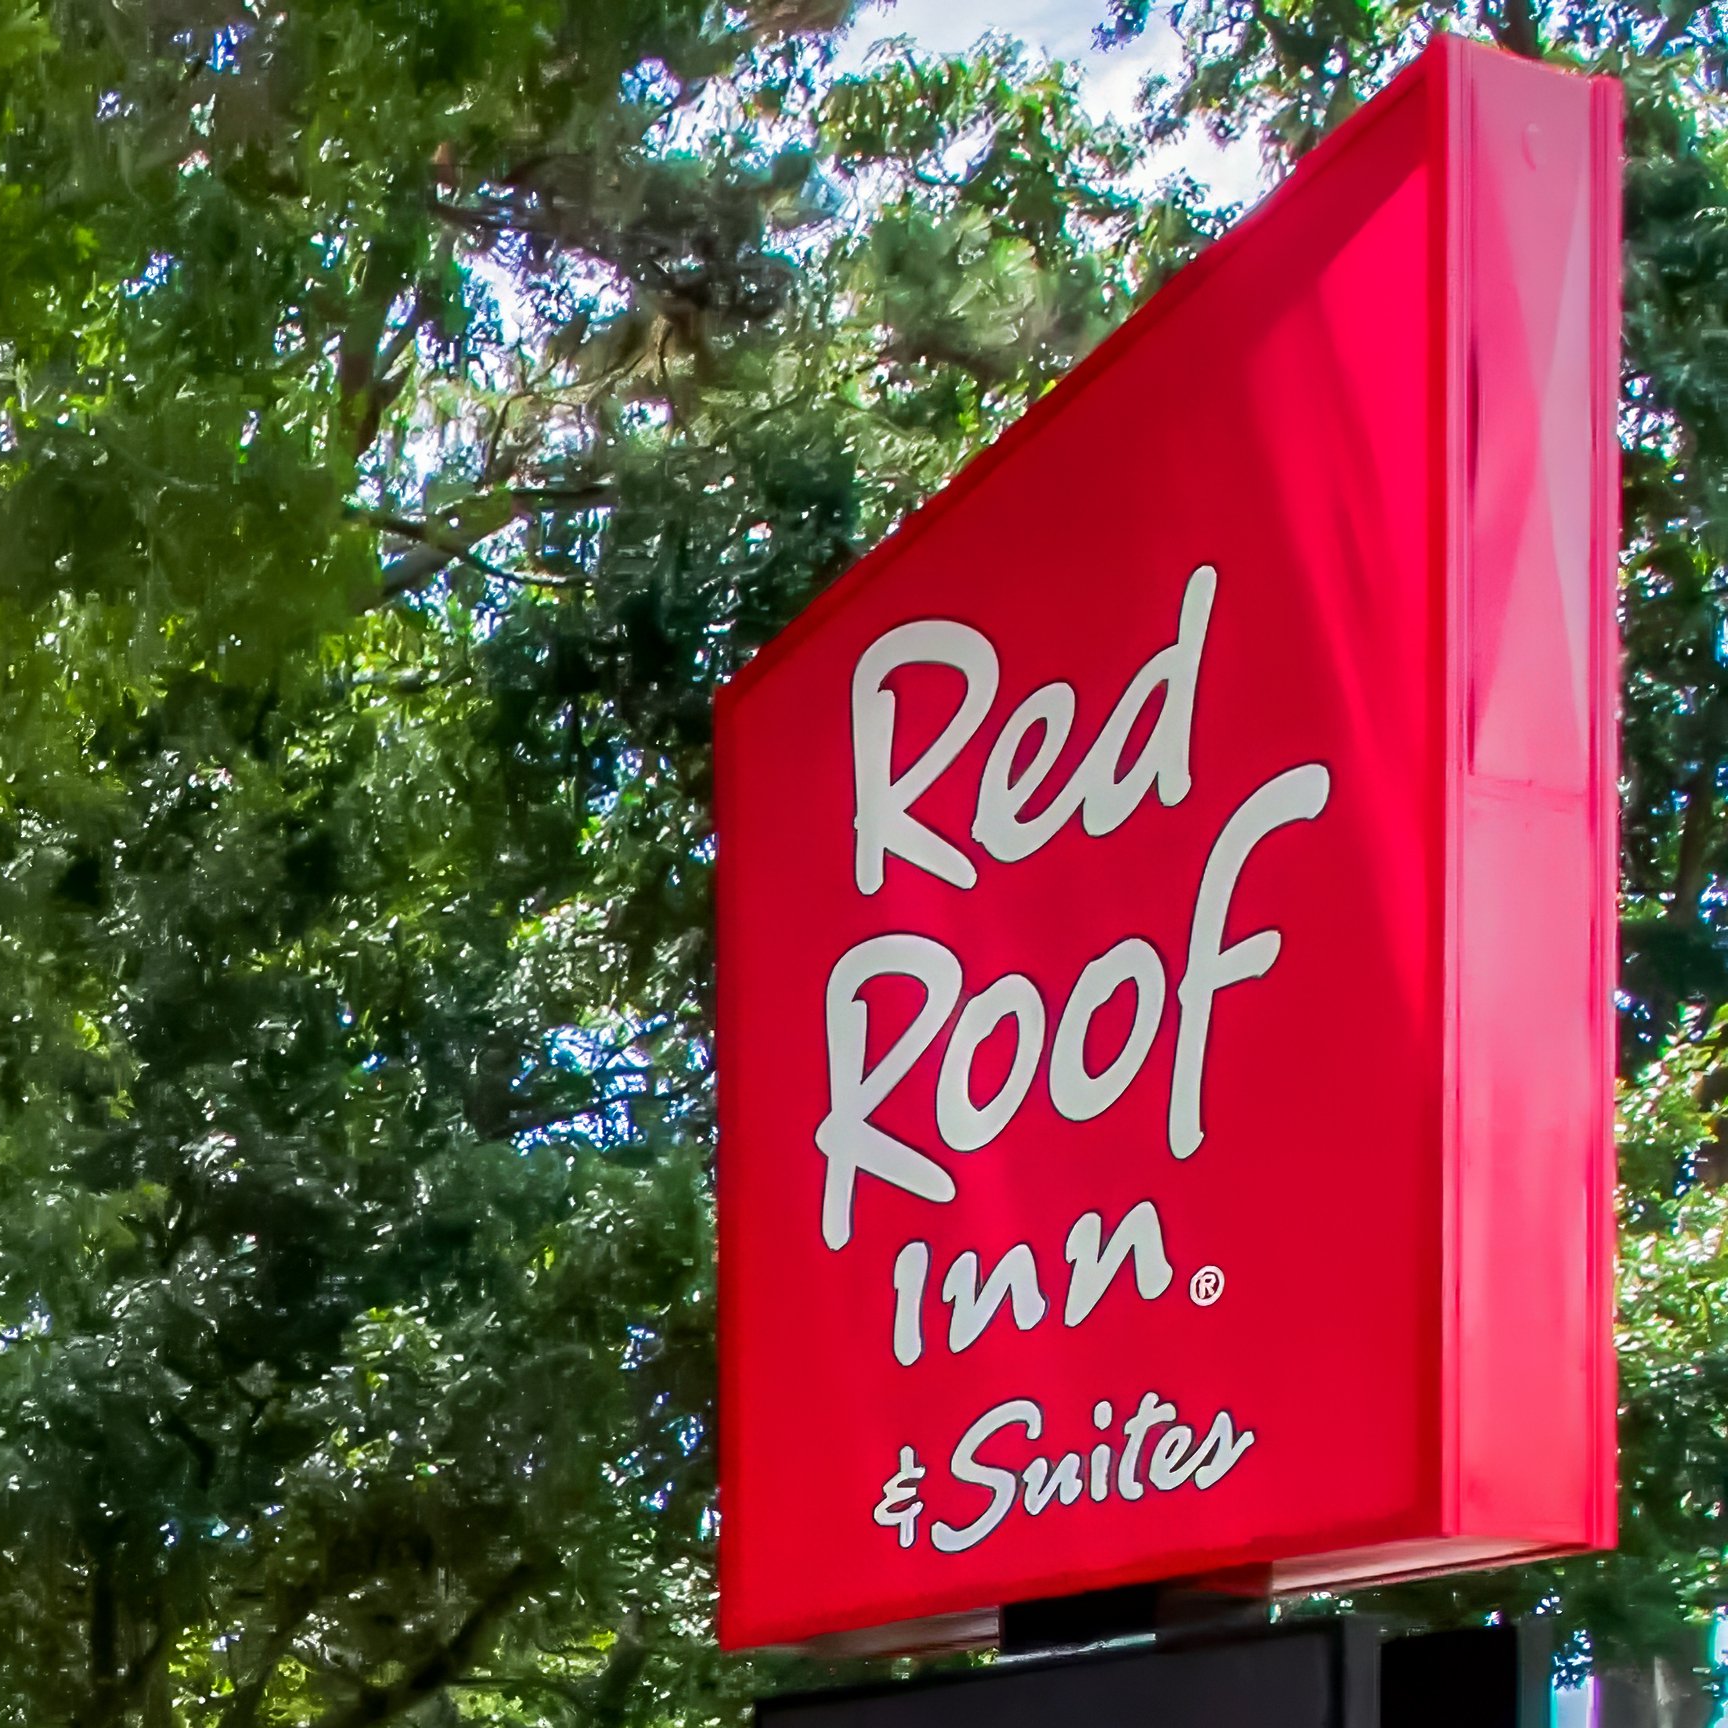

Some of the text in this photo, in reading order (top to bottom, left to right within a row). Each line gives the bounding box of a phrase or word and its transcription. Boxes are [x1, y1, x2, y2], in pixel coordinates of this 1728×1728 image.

[851, 565, 1218, 895] Red
[814, 763, 1330, 1251] Roof
[873, 1391, 1255, 1552] & Suites
